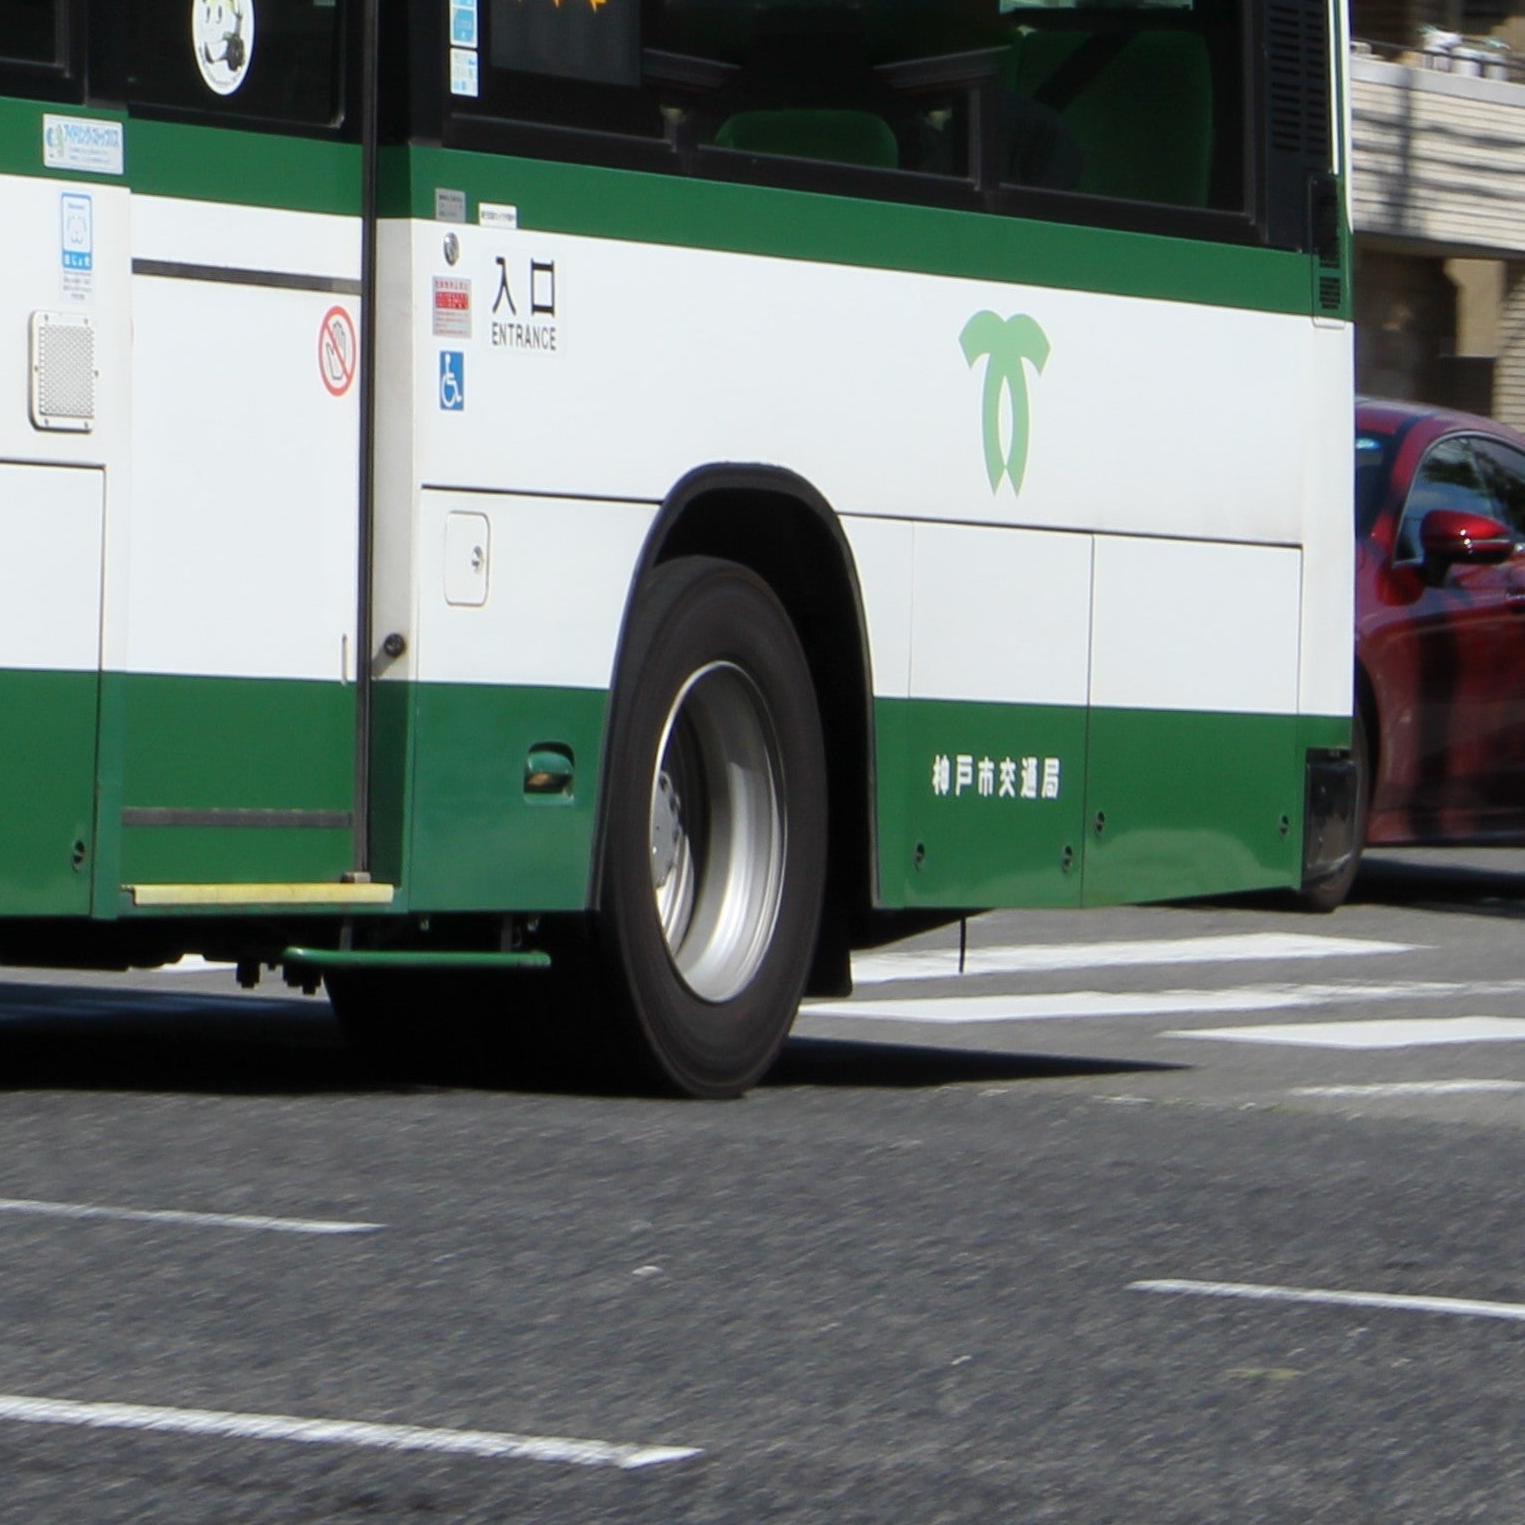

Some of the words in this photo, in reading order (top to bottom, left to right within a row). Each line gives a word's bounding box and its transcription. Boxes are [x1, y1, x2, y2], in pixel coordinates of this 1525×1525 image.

[491, 256, 557, 318] 入口
[491, 321, 558, 352] ENTRANCE
[931, 753, 1060, 800] 神戸市交通局
